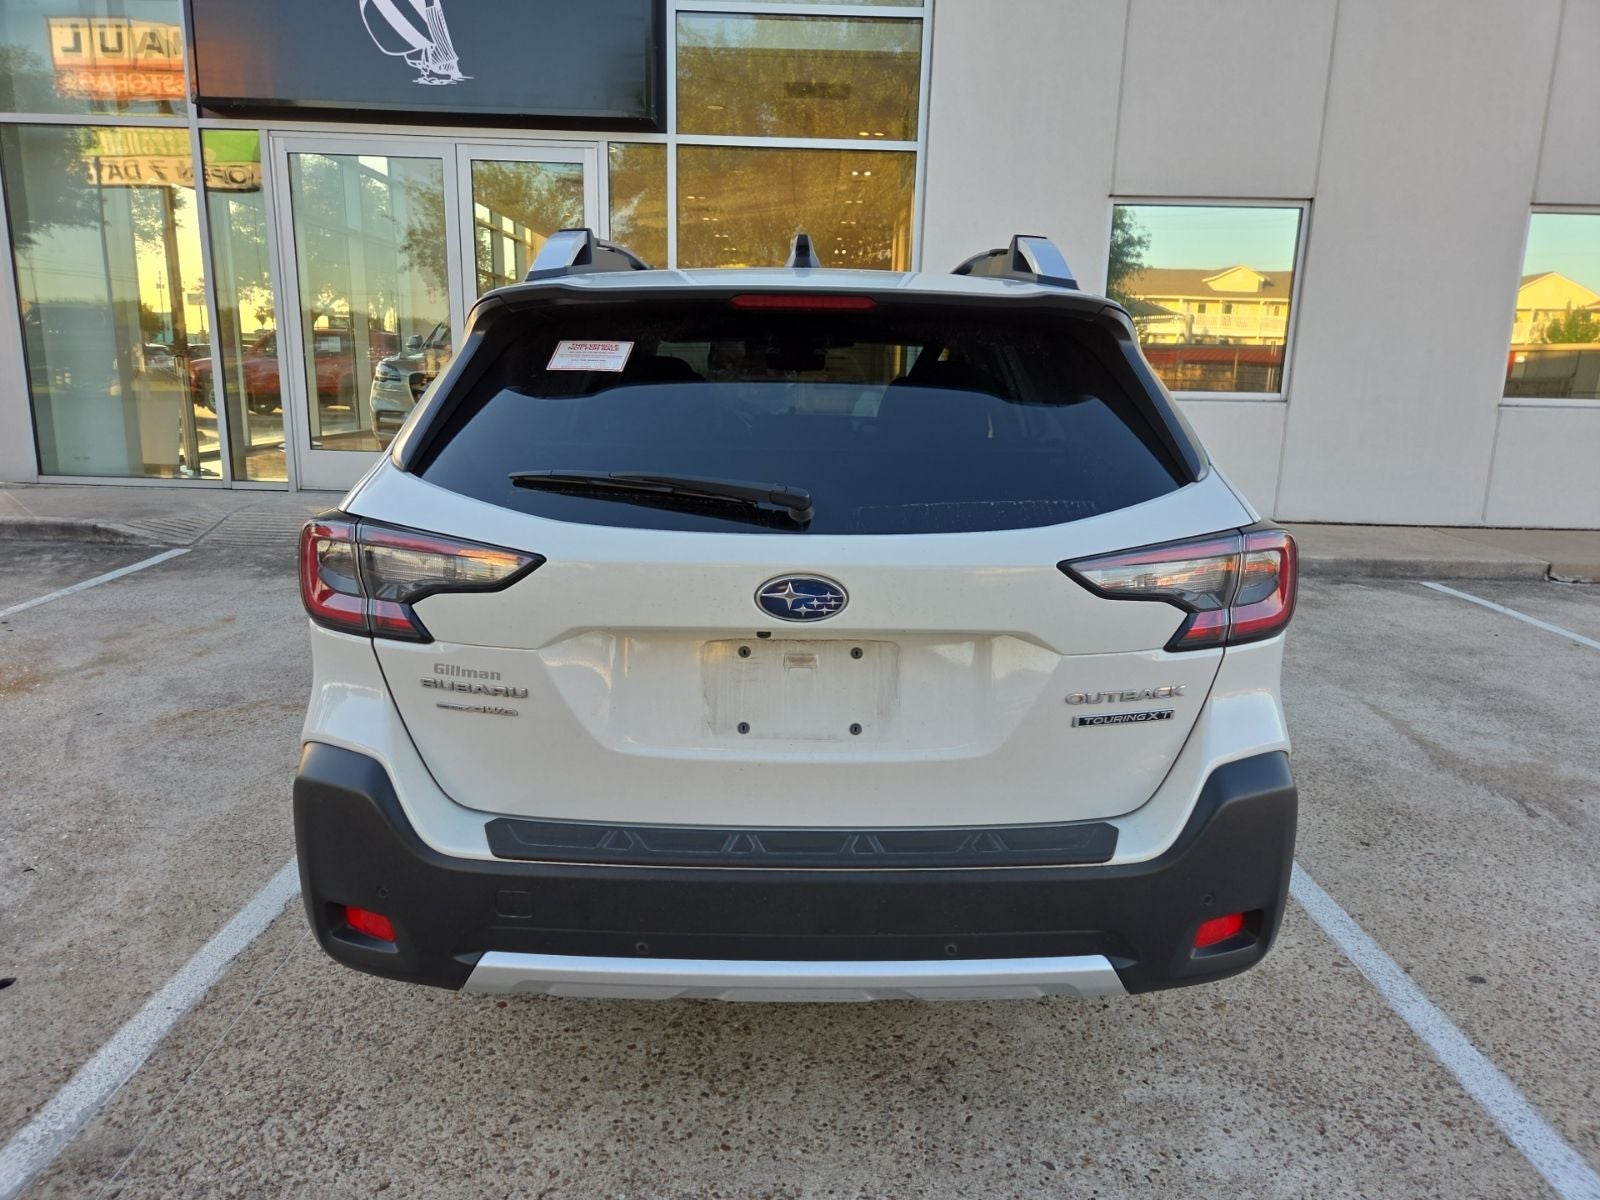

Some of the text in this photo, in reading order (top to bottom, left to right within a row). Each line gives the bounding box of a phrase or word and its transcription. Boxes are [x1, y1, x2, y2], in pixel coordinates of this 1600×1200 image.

[433, 663, 501, 680] Gillman
[420, 679, 528, 698] SUBARU
[1065, 684, 1185, 705] OUTBACK
